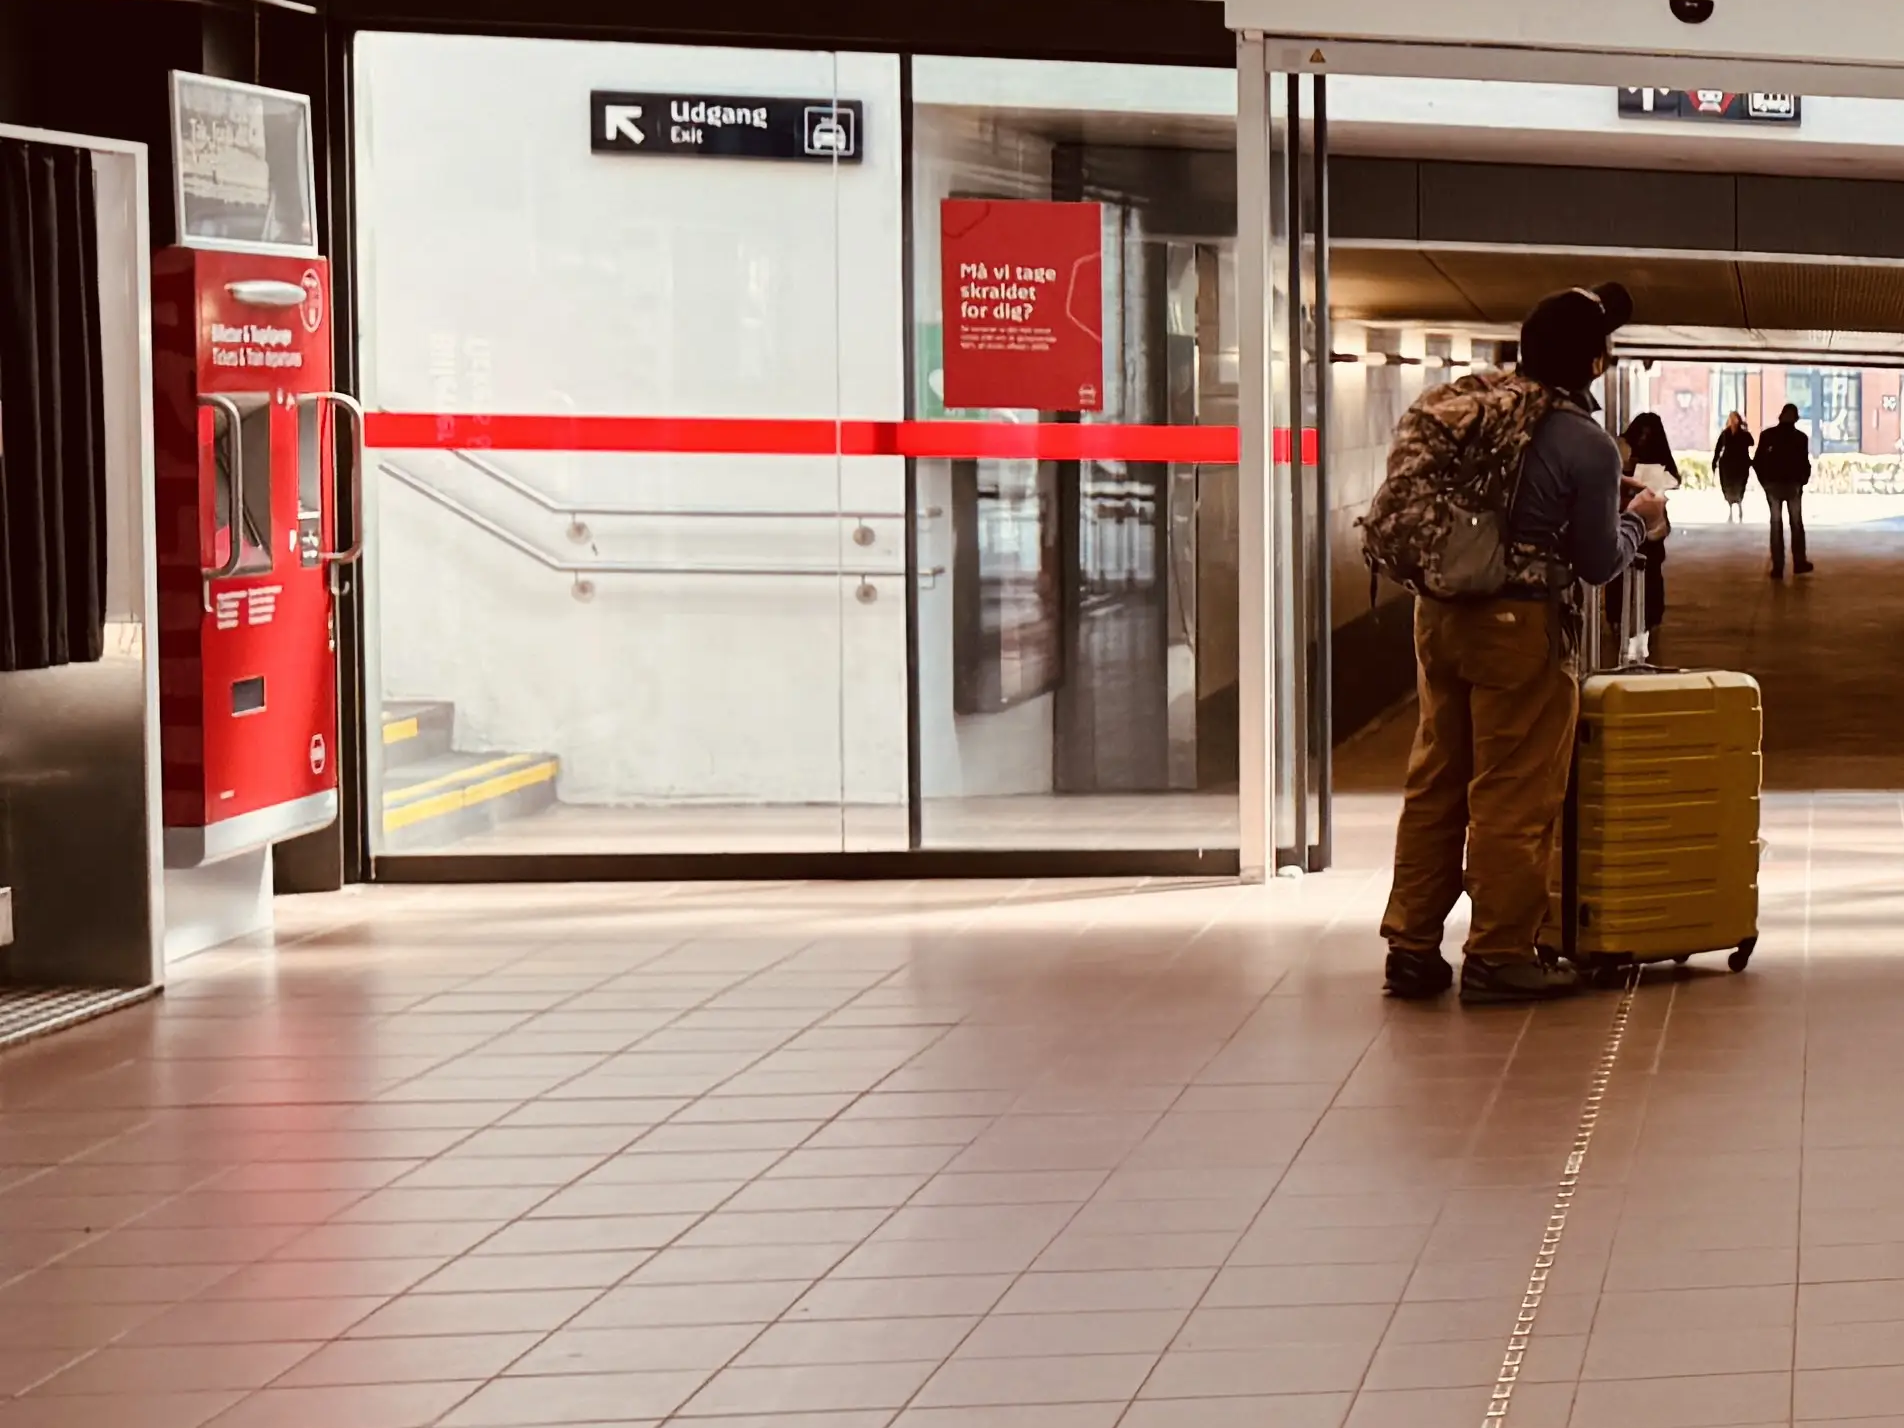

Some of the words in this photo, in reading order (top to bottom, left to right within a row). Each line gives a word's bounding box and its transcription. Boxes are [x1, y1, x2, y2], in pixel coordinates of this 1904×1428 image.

[670, 100, 768, 129] Udgang
[670, 125, 703, 144] Exit
[960, 262, 988, 280] Må
[993, 263, 1010, 280] vi
[1016, 267, 1057, 283] tage
[960, 282, 1037, 300] skraldet
[960, 301, 988, 318] for
[993, 302, 1034, 322] dig?
